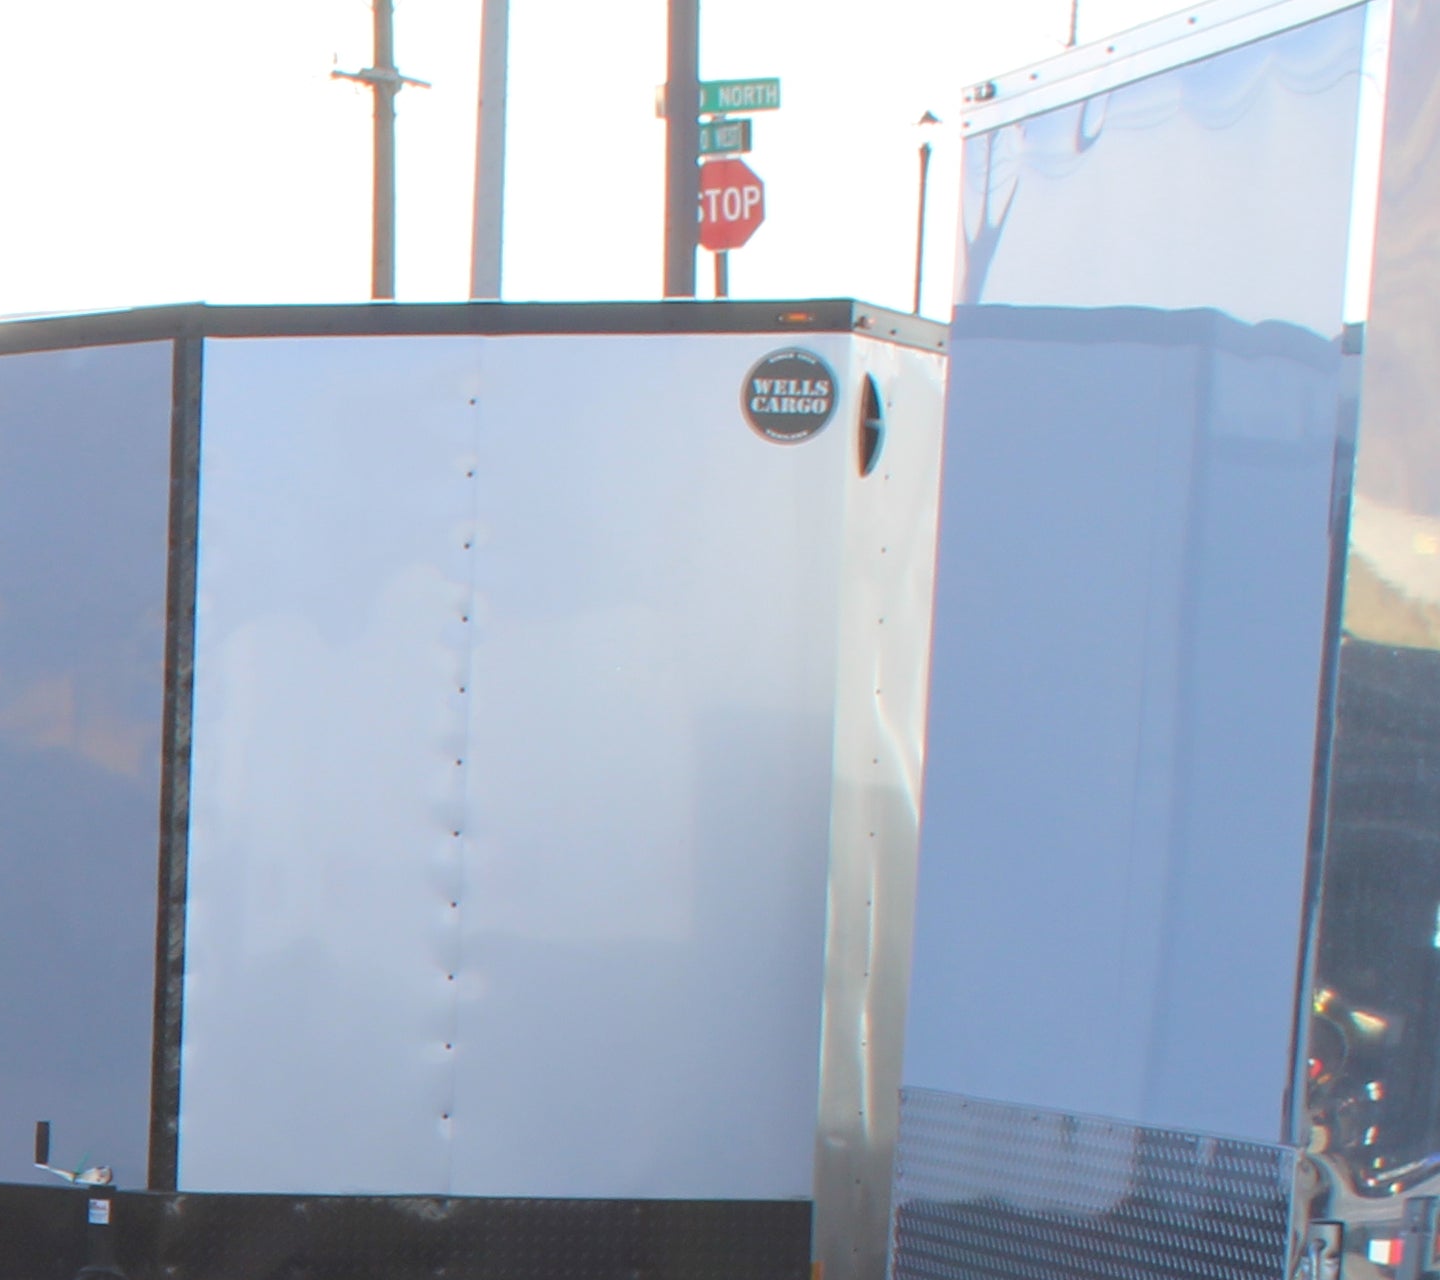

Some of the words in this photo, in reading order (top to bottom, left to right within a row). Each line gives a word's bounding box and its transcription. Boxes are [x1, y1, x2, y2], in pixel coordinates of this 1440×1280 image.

[719, 84, 779, 108] NORTH
[752, 379, 829, 397] WELLS
[750, 396, 827, 414] CARGO
